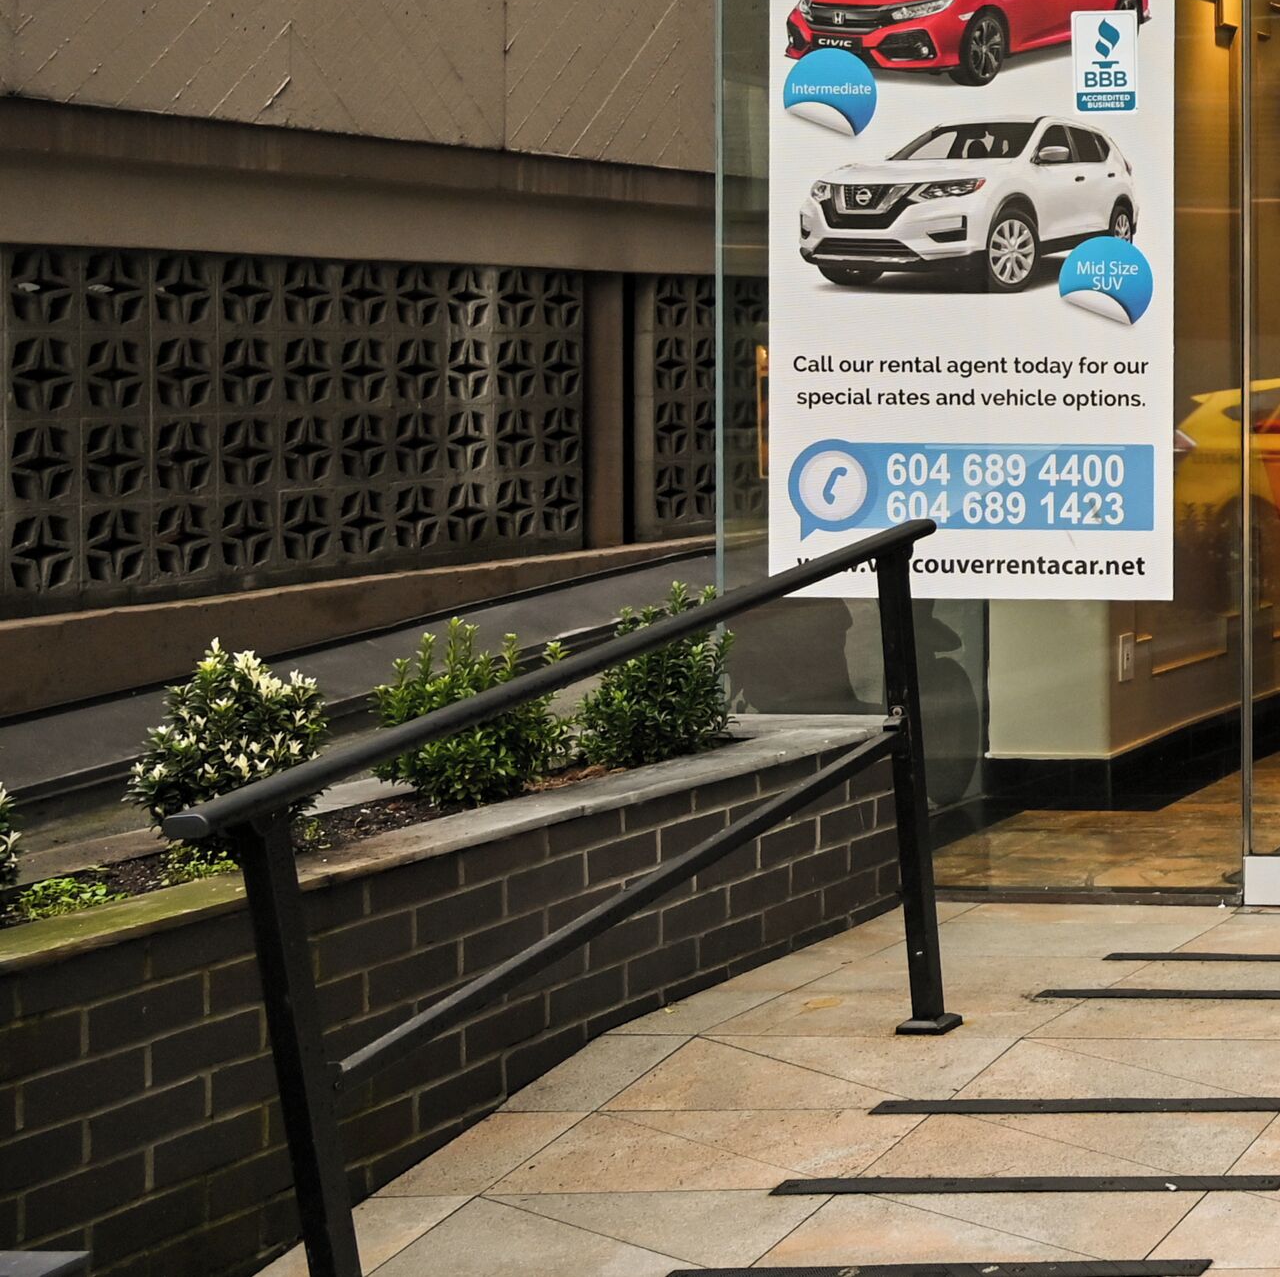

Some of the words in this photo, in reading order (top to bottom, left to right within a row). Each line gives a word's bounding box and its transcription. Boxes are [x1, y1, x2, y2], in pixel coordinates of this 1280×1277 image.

[818, 38, 853, 48] CIVIC
[1084, 71, 1128, 88] BBB
[791, 83, 872, 95] Intermediate
[1081, 94, 1131, 102] ACCREDITED
[1087, 101, 1125, 109] BUSINESS
[1076, 260, 1104, 276] Mid
[1108, 260, 1139, 277] Size
[1092, 276, 1123, 292] SUV
[793, 355, 834, 374] Call
[839, 360, 874, 374] our
[879, 355, 942, 374] rental
[946, 357, 1008, 379] agent
[1013, 356, 1074, 379] today
[1078, 356, 1109, 374] for
[1113, 361, 1149, 375] our
[796, 387, 873, 410] special
[877, 388, 931, 406] rates
[935, 388, 976, 406] and
[980, 388, 1057, 407] vehicle
[1062, 389, 1146, 412] options.
[886, 452, 951, 486] 604
[962, 452, 1026, 487] 689
[1038, 451, 1125, 487] 4400
[886, 491, 951, 523] 604
[962, 491, 1026, 525] 689
[1041, 491, 1125, 525] 1423
